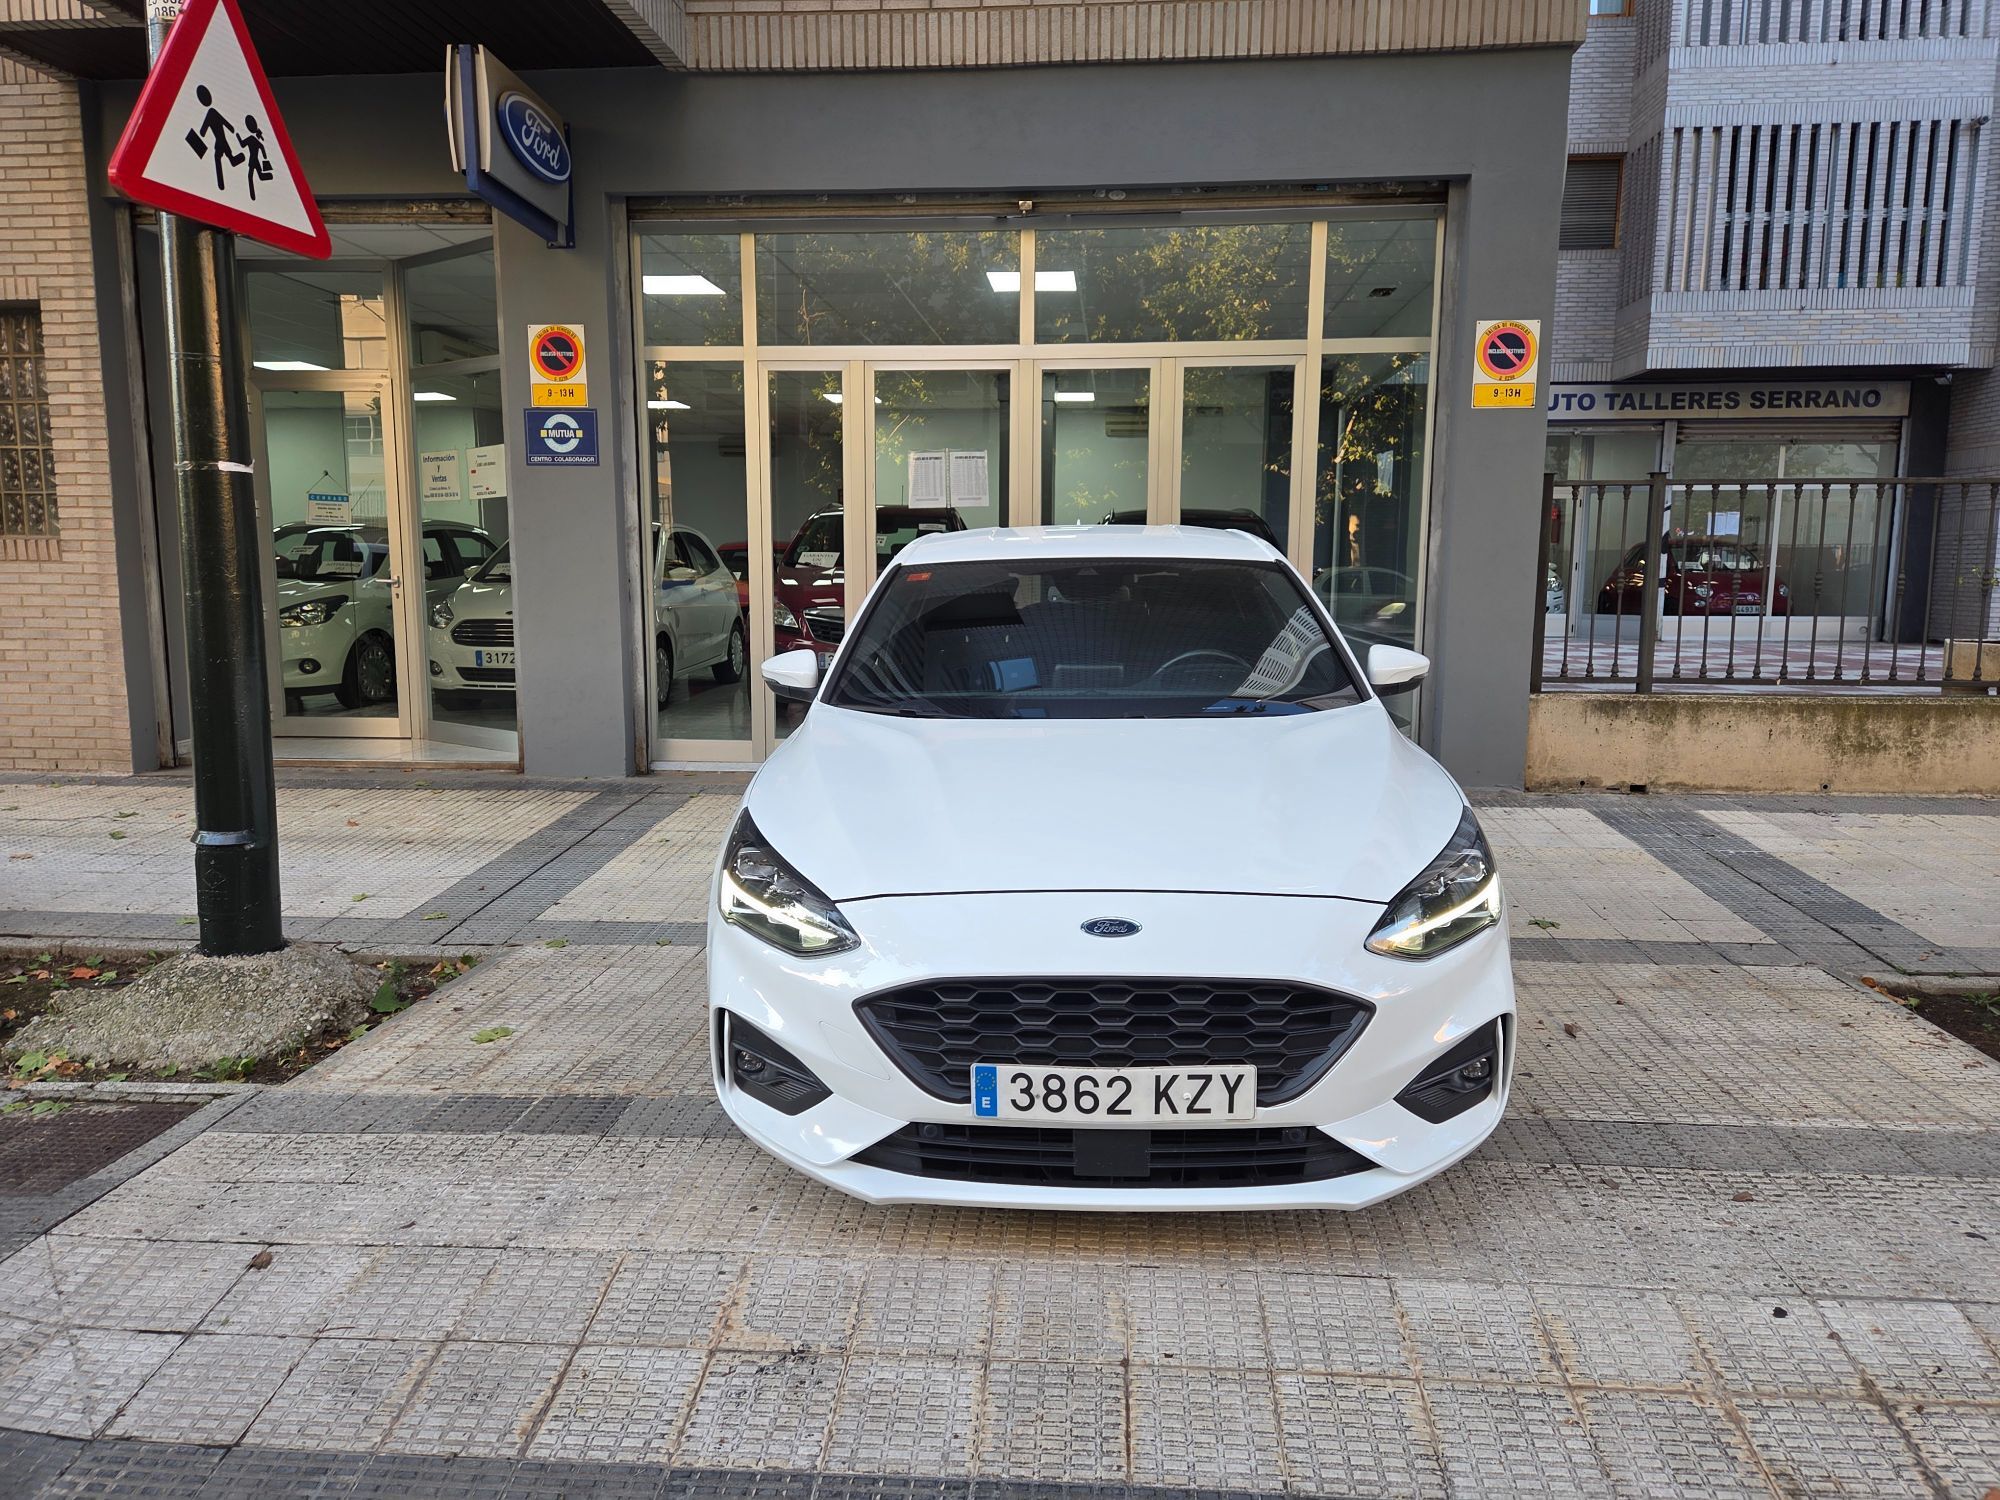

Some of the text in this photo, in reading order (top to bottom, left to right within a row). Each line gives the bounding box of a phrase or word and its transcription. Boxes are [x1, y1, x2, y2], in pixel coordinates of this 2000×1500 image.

[1485, 324, 1501, 336] SALIDA
[1604, 391, 1740, 411] TALLERES
[1749, 389, 1882, 409] SERRANO
[548, 429, 575, 438] MUTUA
[422, 453, 455, 463] Información
[431, 474, 447, 482] Ventas
[485, 652, 515, 664] 3172
[982, 1072, 1244, 1115] E 3862 KZY
